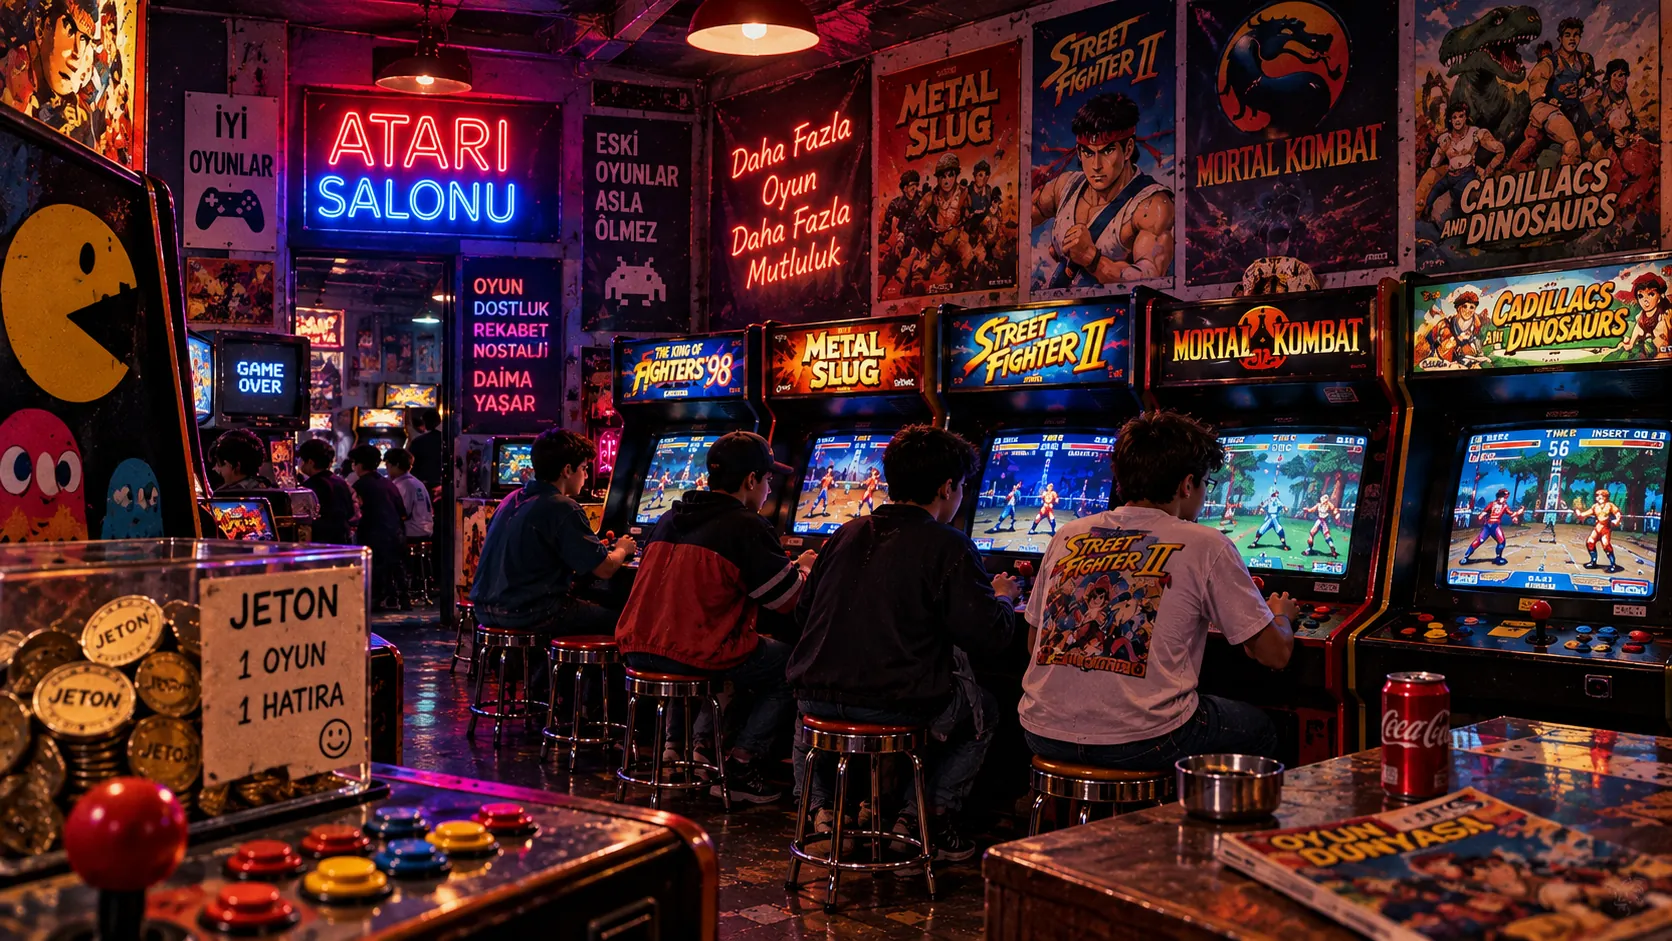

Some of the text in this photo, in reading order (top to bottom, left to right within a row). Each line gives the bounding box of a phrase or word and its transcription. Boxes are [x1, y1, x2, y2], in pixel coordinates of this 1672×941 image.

[1040, 12, 1149, 90] STREET
[1055, 30, 1167, 107] FIGHTER II
[896, 69, 998, 125] METAL
[328, 111, 508, 172] ATARI
[596, 129, 639, 156] ESKİ
[731, 111, 852, 179] Daha Fazla
[905, 106, 992, 158] SLUG
[190, 150, 273, 178] OYUNLAR
[595, 160, 679, 188] OYUNLAR
[1195, 123, 1382, 188] MORTAL KOMBAT
[318, 175, 515, 223] SALONU
[595, 189, 644, 213] ASLA
[762, 171, 817, 211] Oyun
[1460, 158, 1611, 213] CADILLACS
[731, 195, 852, 257] Daha Fazla
[1440, 192, 1617, 245] AND DINOSAURS
[746, 236, 841, 289] Mutluluk
[473, 277, 523, 295] OYUN
[1492, 281, 1616, 328] CADILLACS
[474, 301, 549, 316] DOSTLUK
[473, 322, 549, 337] REKABET
[802, 331, 885, 362] METAL
[963, 312, 1058, 377] STREET
[1173, 318, 1364, 361] MORTAL KOMBAT
[1506, 307, 1630, 352] DINOSAURS
[237, 361, 284, 378] GAME
[655, 343, 704, 359] THE KING OF
[985, 316, 1116, 384] FIGHTER II
[238, 378, 282, 394] OVER
[473, 366, 532, 388] DAİMA
[810, 359, 880, 389] SLUG
[473, 394, 535, 415] YAŞAR
[1548, 440, 1570, 457] 56
[1591, 429, 1629, 438] INSERT
[1057, 533, 1145, 566] STREET
[1060, 543, 1185, 584] FIGHTER II
[230, 584, 339, 630] JETON
[95, 612, 150, 650] JETON
[238, 641, 326, 680] 1 OYUN
[48, 688, 121, 709] JETON
[238, 682, 345, 725] 1 HATIRA
[1271, 822, 1388, 852] OYUN
